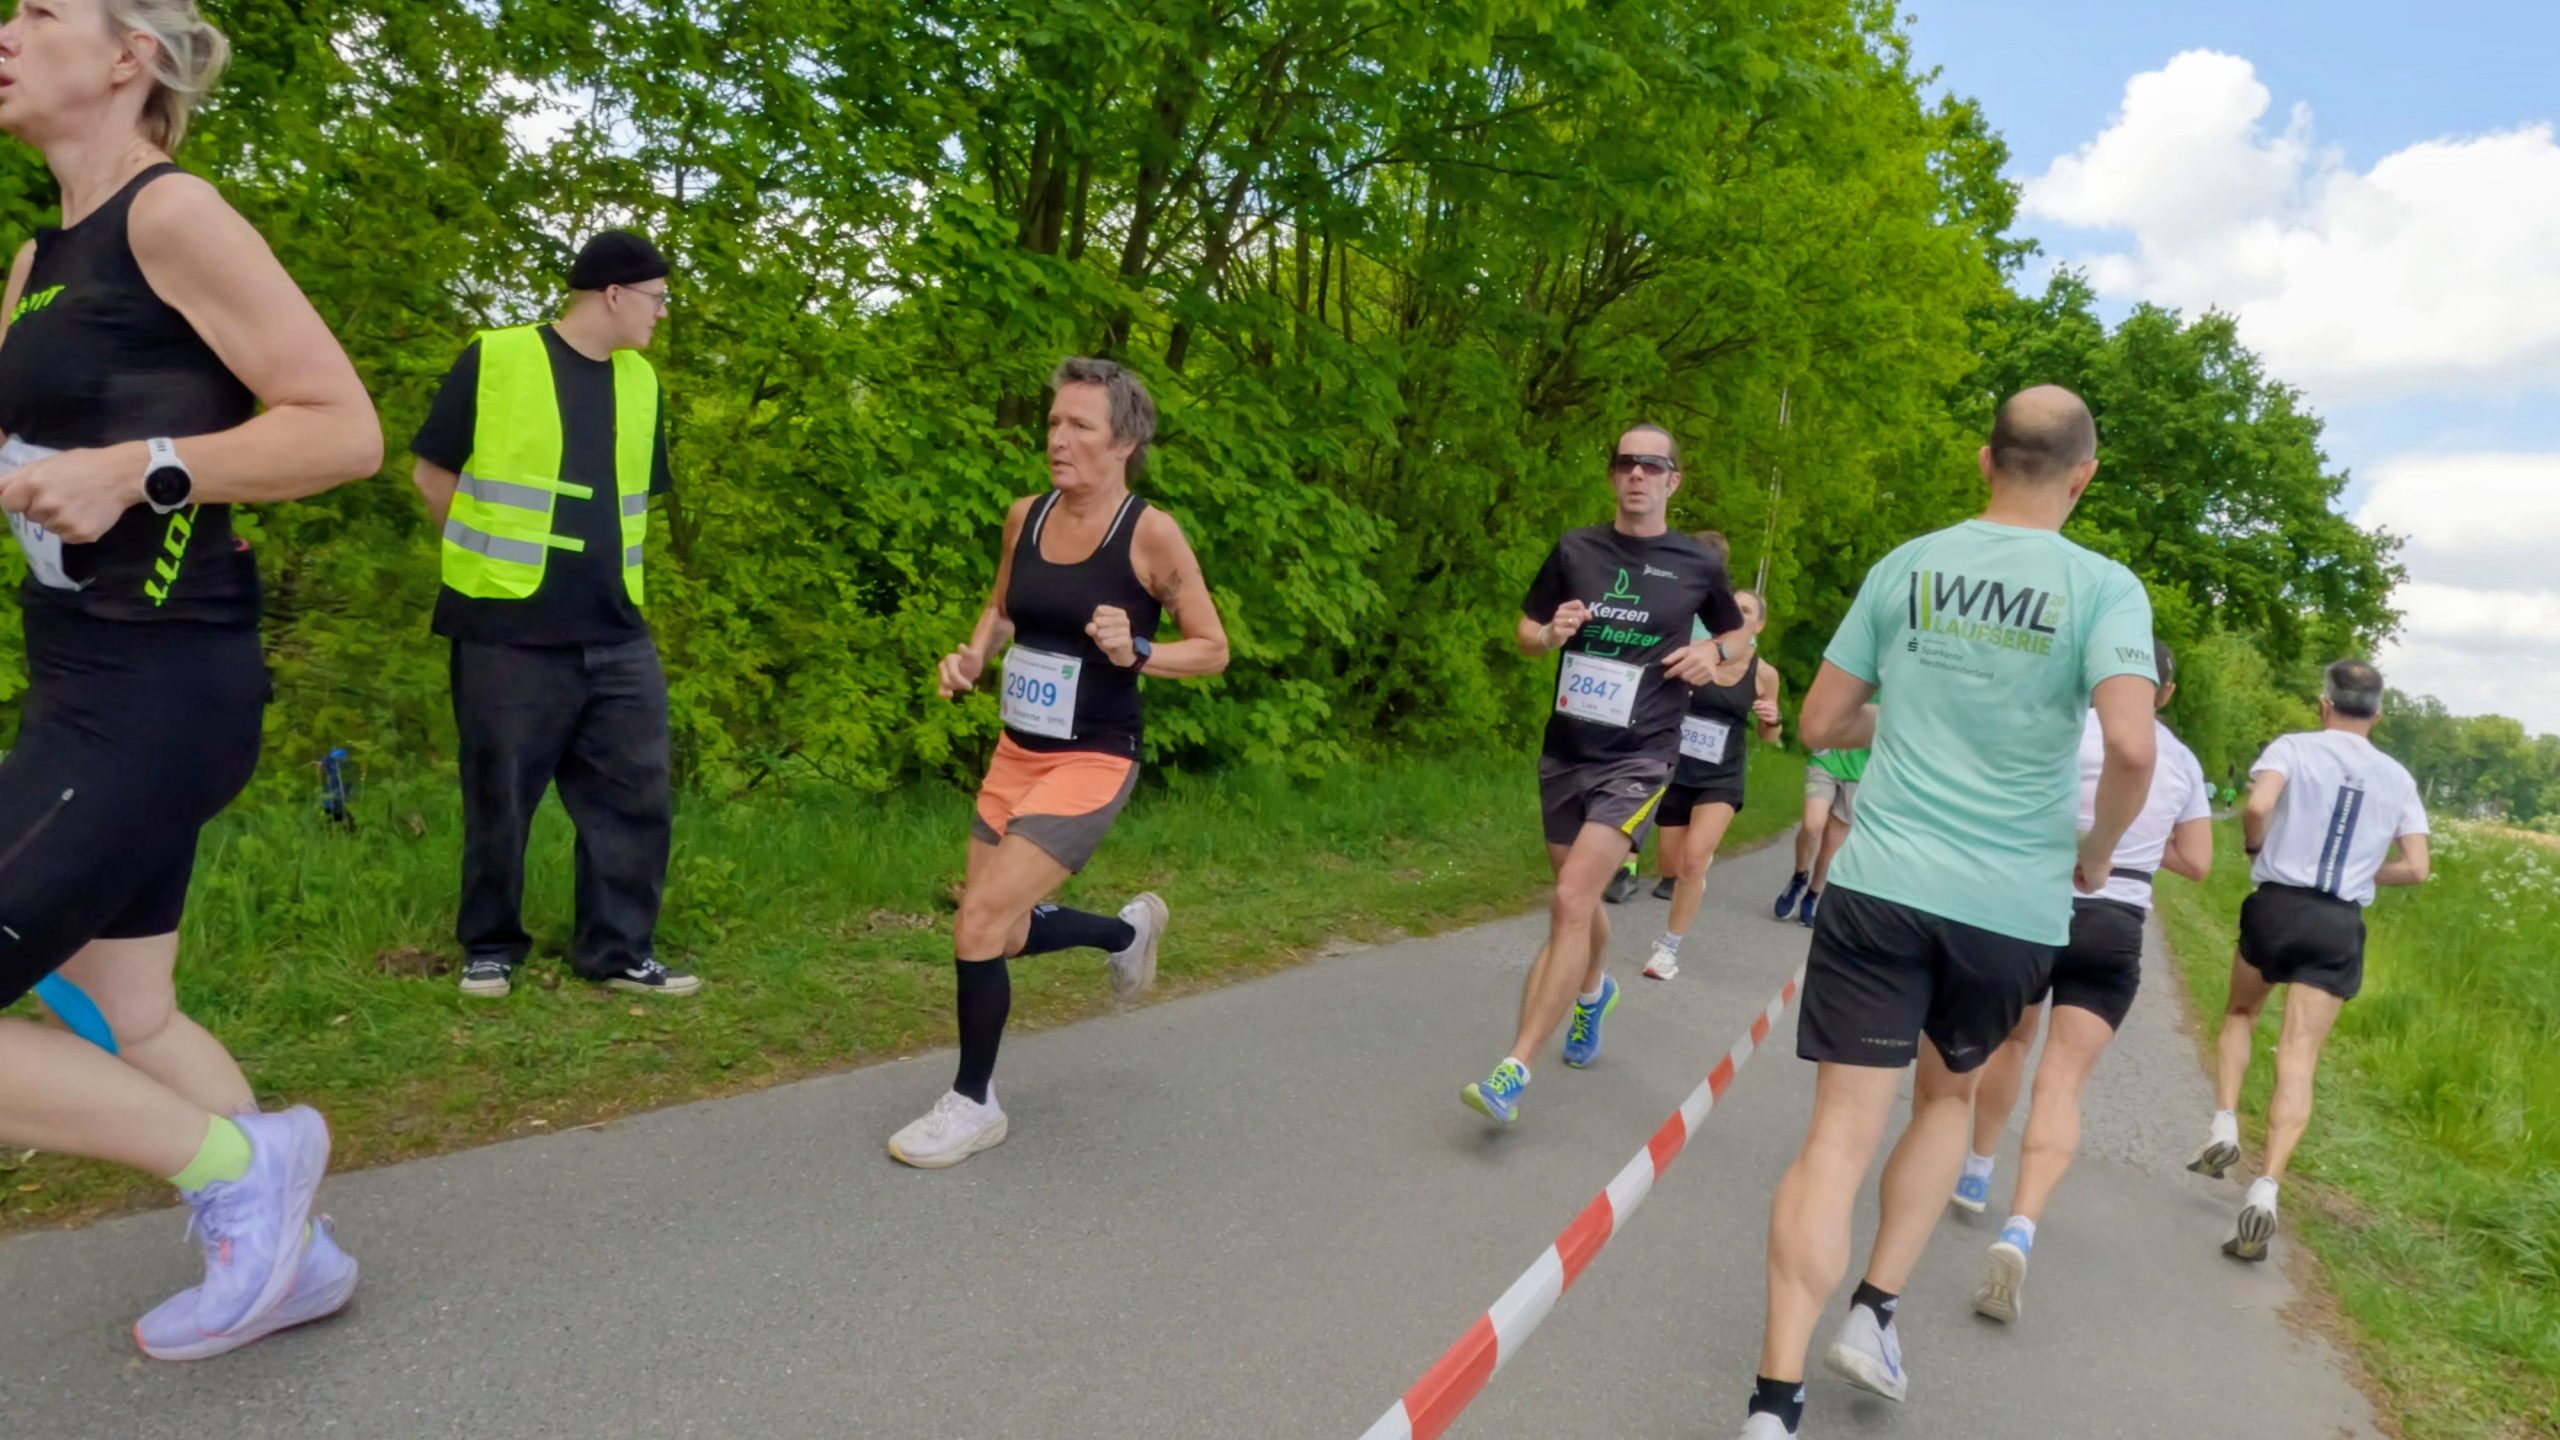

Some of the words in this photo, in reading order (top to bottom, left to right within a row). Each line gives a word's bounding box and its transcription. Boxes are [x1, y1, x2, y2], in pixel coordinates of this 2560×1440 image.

[1588, 601, 1650, 624] Kerzen
[1600, 624, 1662, 647] heizer
[1932, 615, 2054, 657] LAUFSERIE
[1007, 672, 1057, 708] 2909
[1568, 673, 1622, 701] 2847
[1681, 729, 1716, 748] 2833
